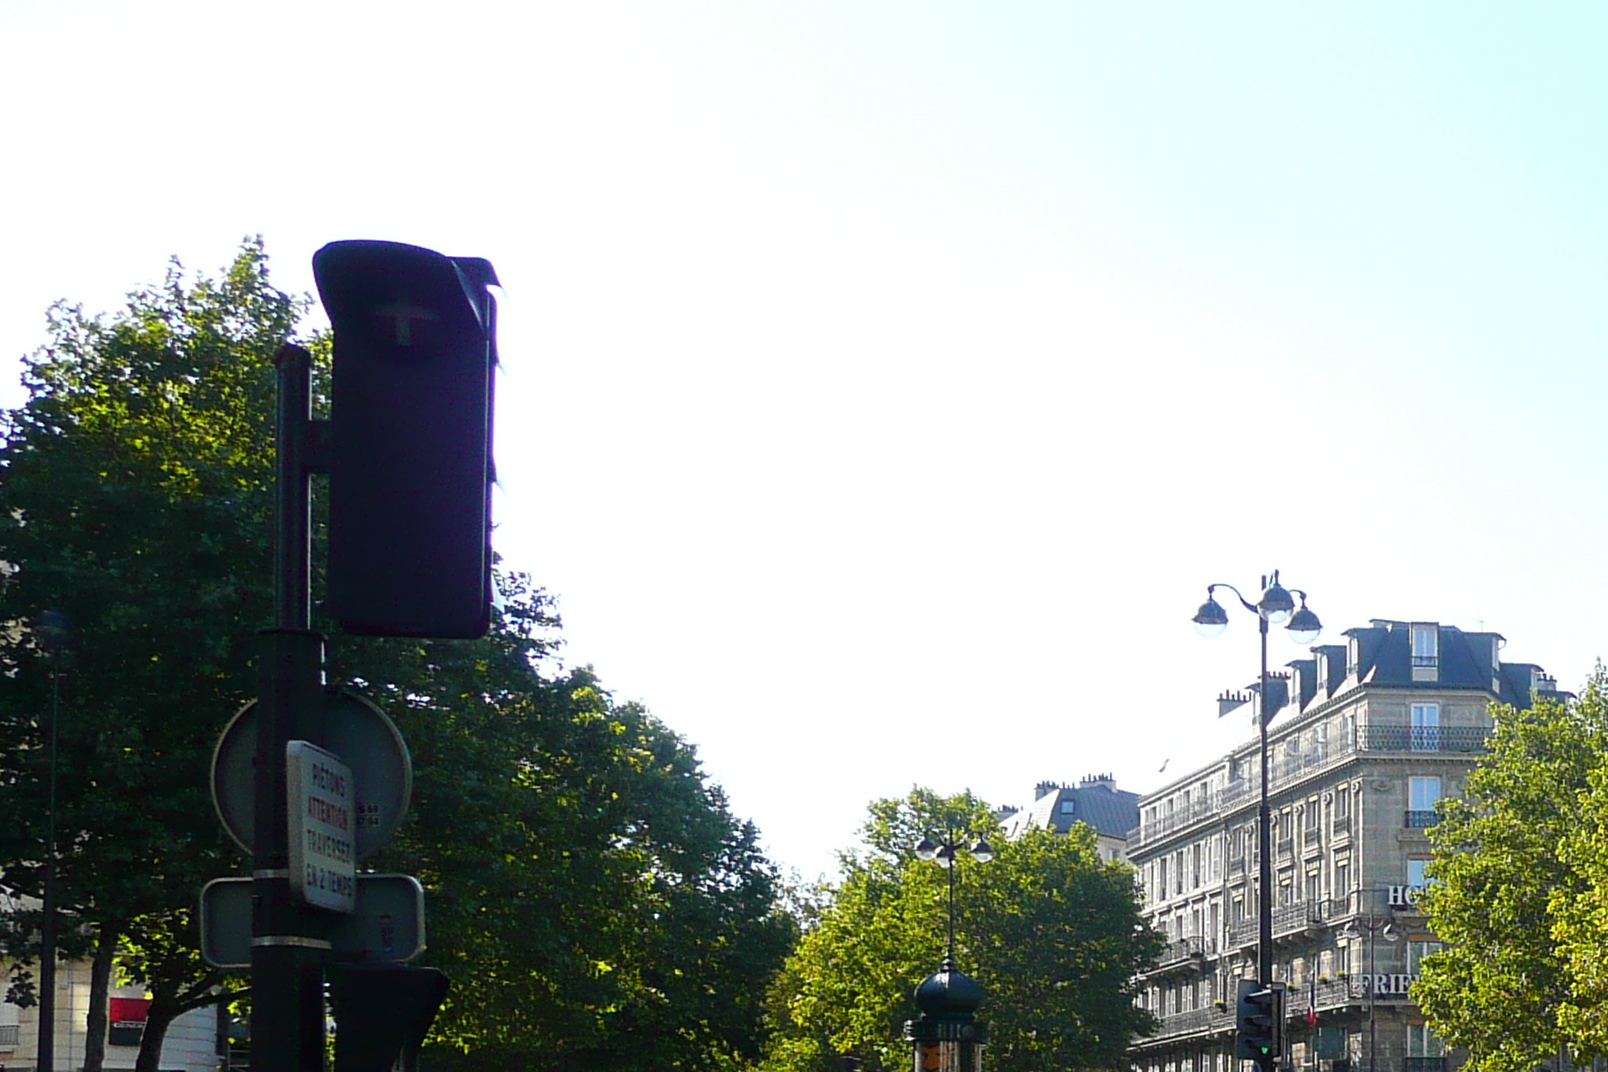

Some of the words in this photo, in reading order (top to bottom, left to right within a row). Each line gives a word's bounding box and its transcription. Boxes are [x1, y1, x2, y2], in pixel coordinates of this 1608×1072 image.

[308, 796, 348, 831] ATTENTION
[306, 863, 318, 887] EN
[319, 867, 326, 889] 2
[327, 869, 352, 898] TEMPS
